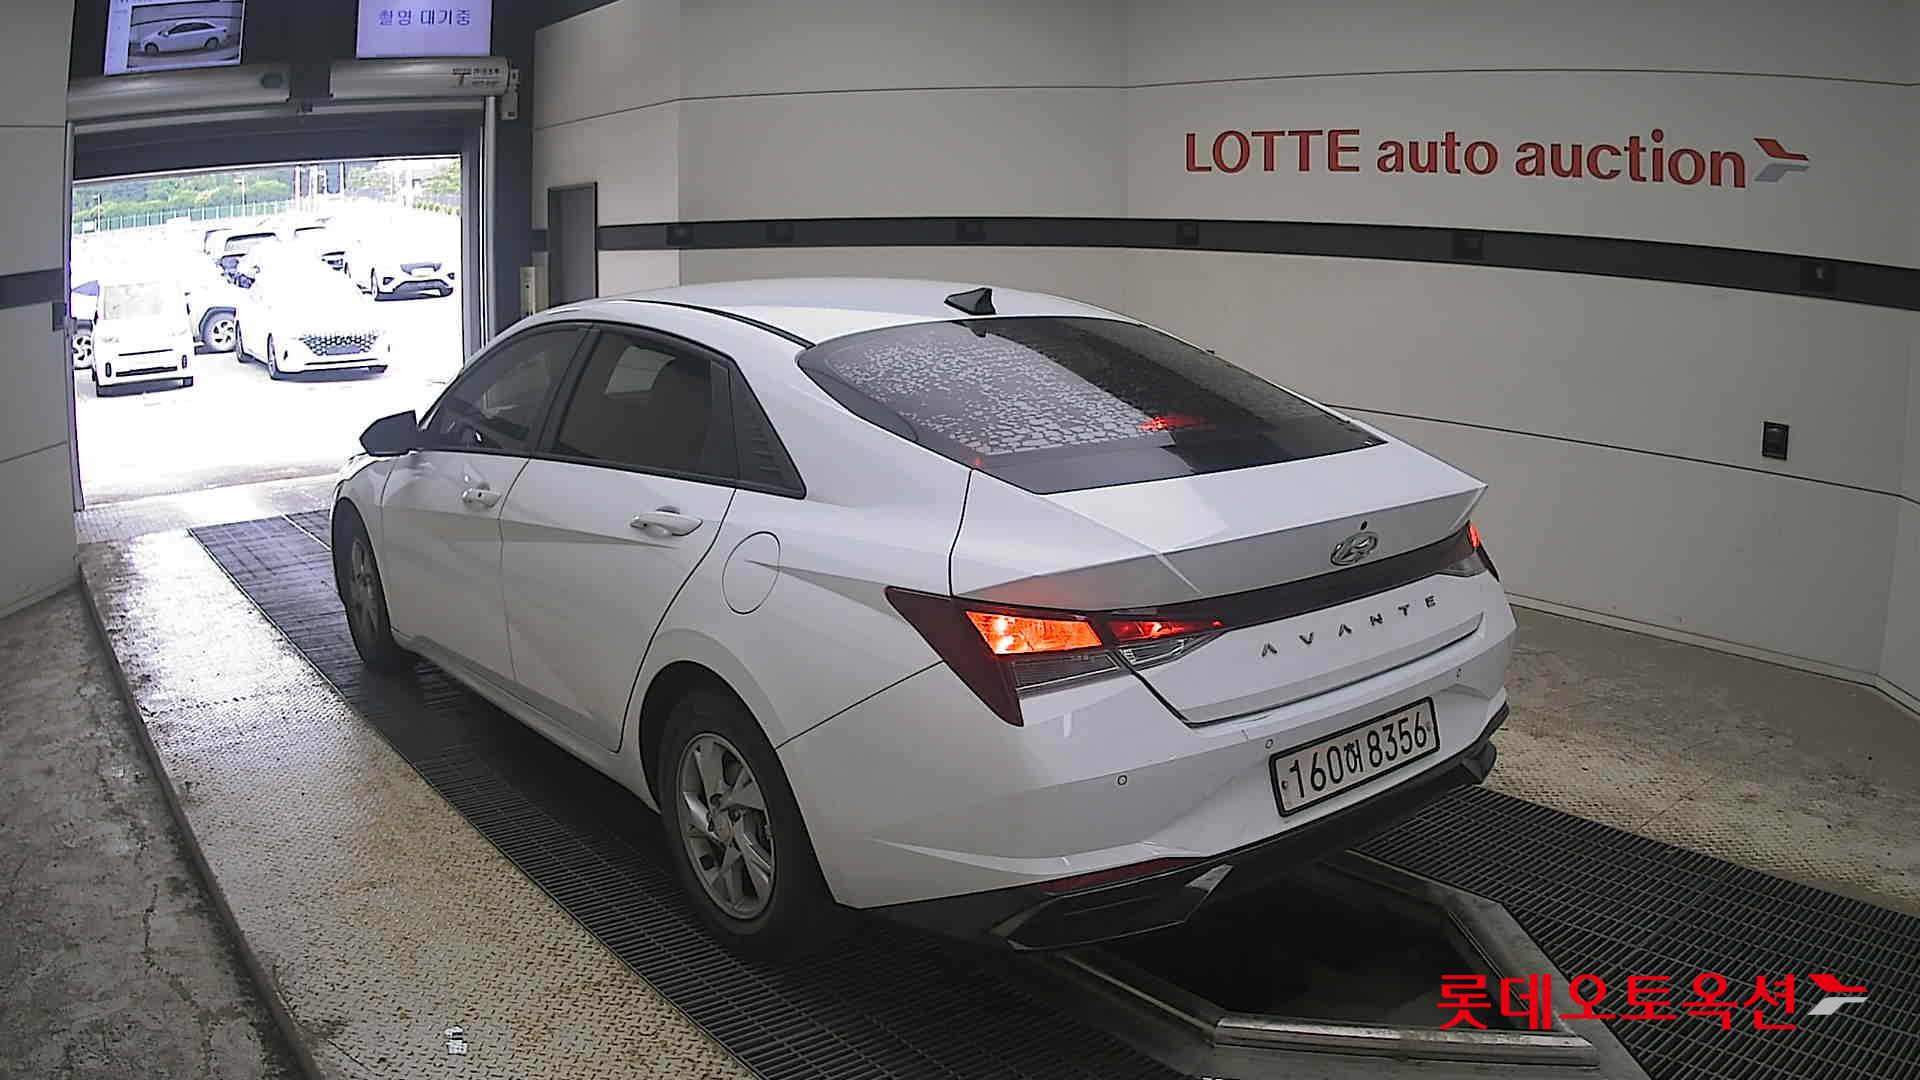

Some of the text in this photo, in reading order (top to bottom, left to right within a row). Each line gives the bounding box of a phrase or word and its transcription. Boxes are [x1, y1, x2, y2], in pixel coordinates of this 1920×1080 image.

[420, 8, 471, 26] 대기중
[1185, 128, 1746, 188] LOTTE auto auction
[1261, 595, 1437, 658] AVANTE
